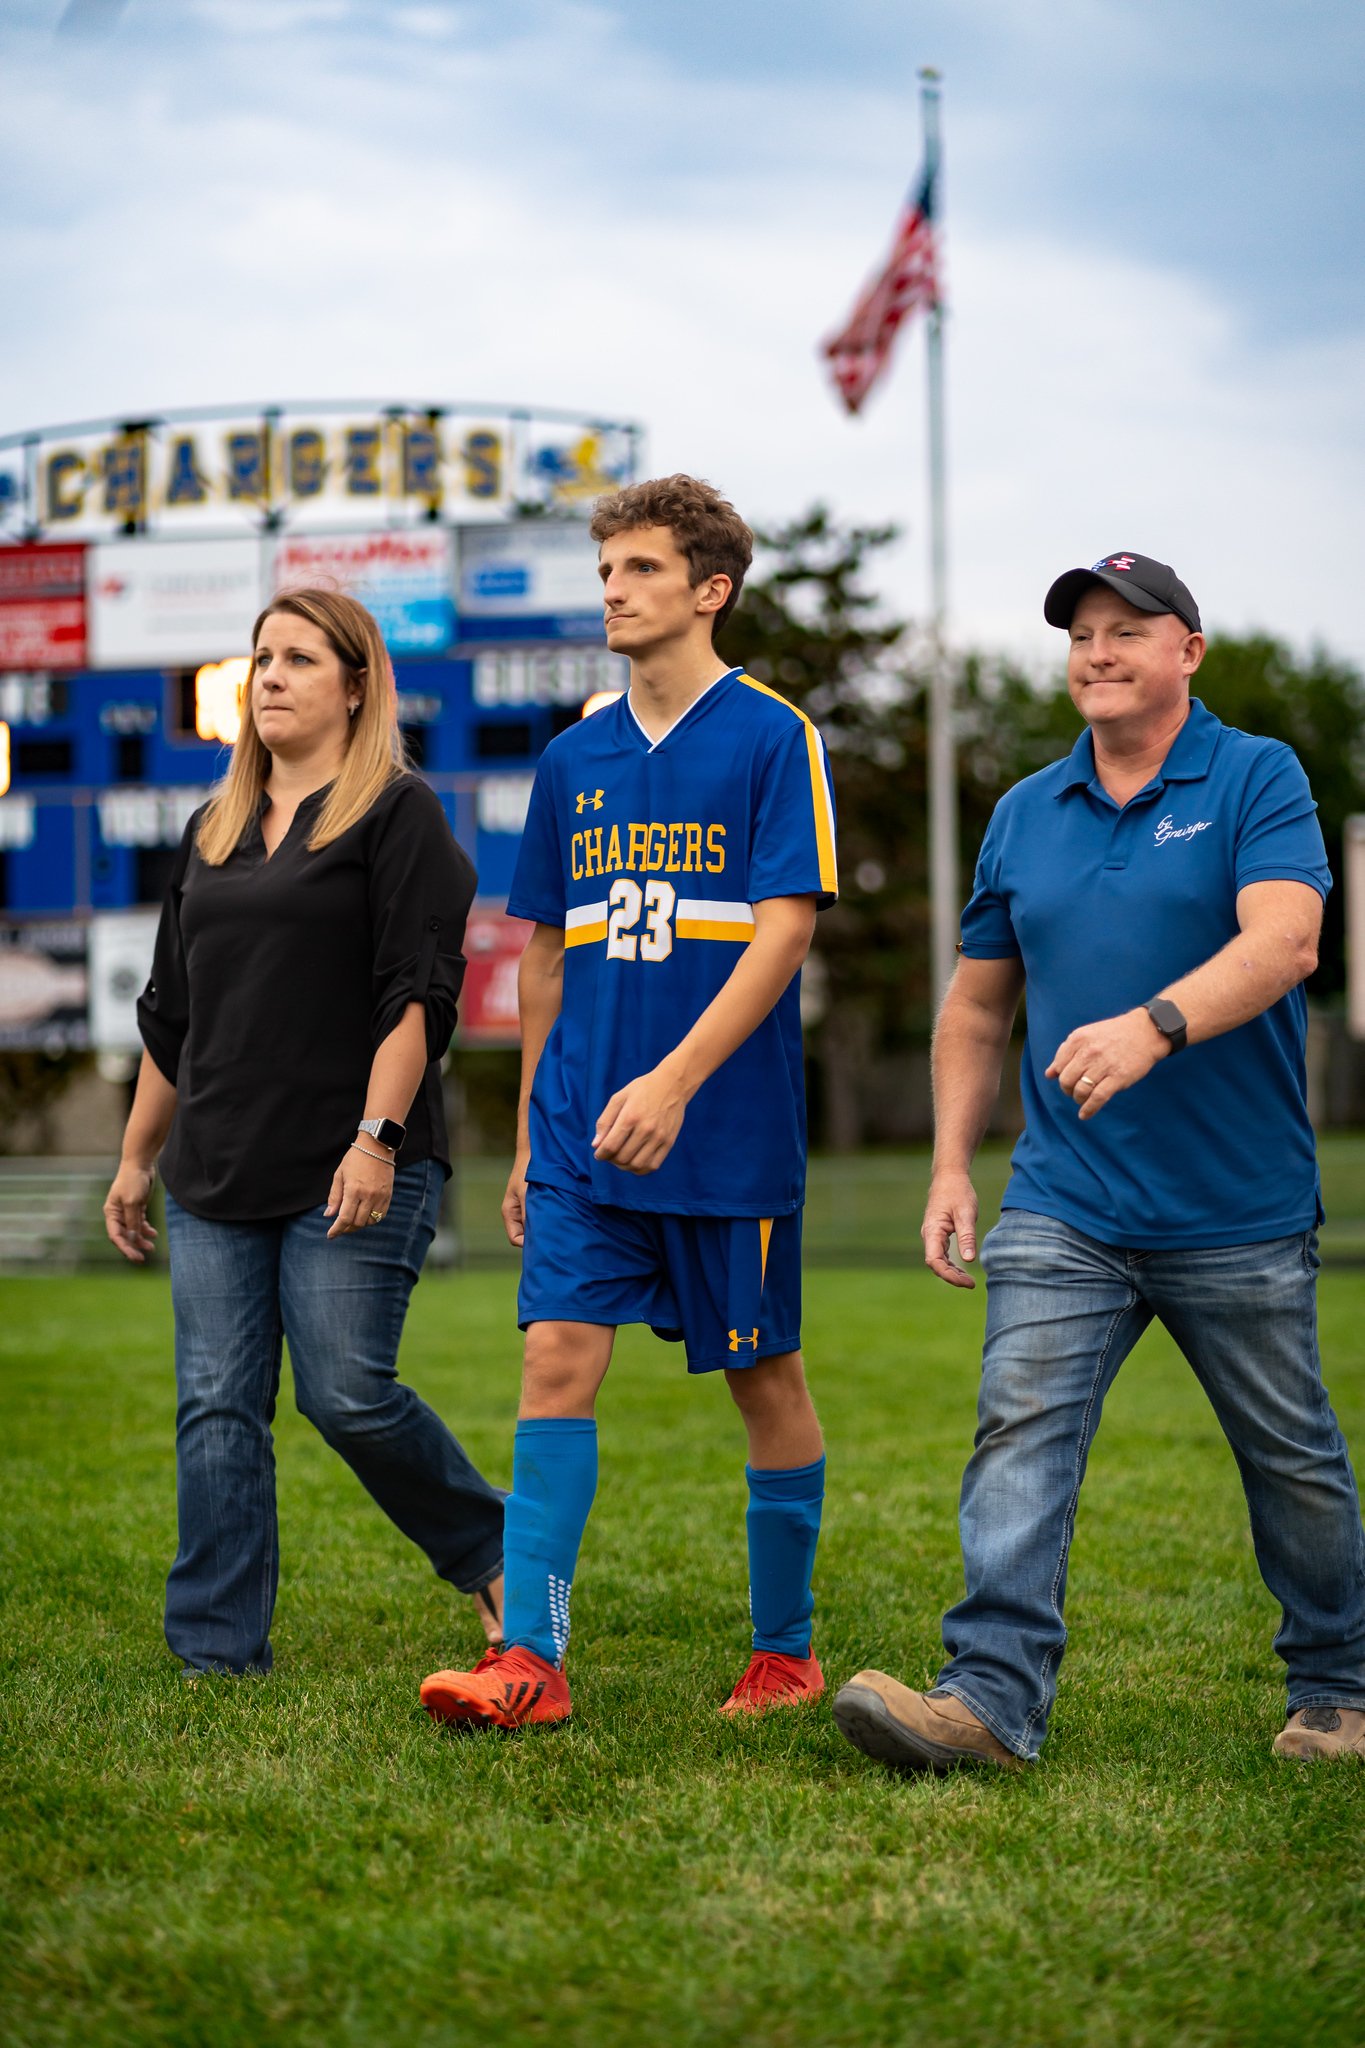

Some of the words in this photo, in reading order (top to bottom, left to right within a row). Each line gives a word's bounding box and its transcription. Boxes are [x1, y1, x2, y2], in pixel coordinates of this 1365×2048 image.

[45, 421, 505, 522] CHARGERS
[571, 821, 727, 881] CHARGERS
[606, 878, 676, 962] 23
